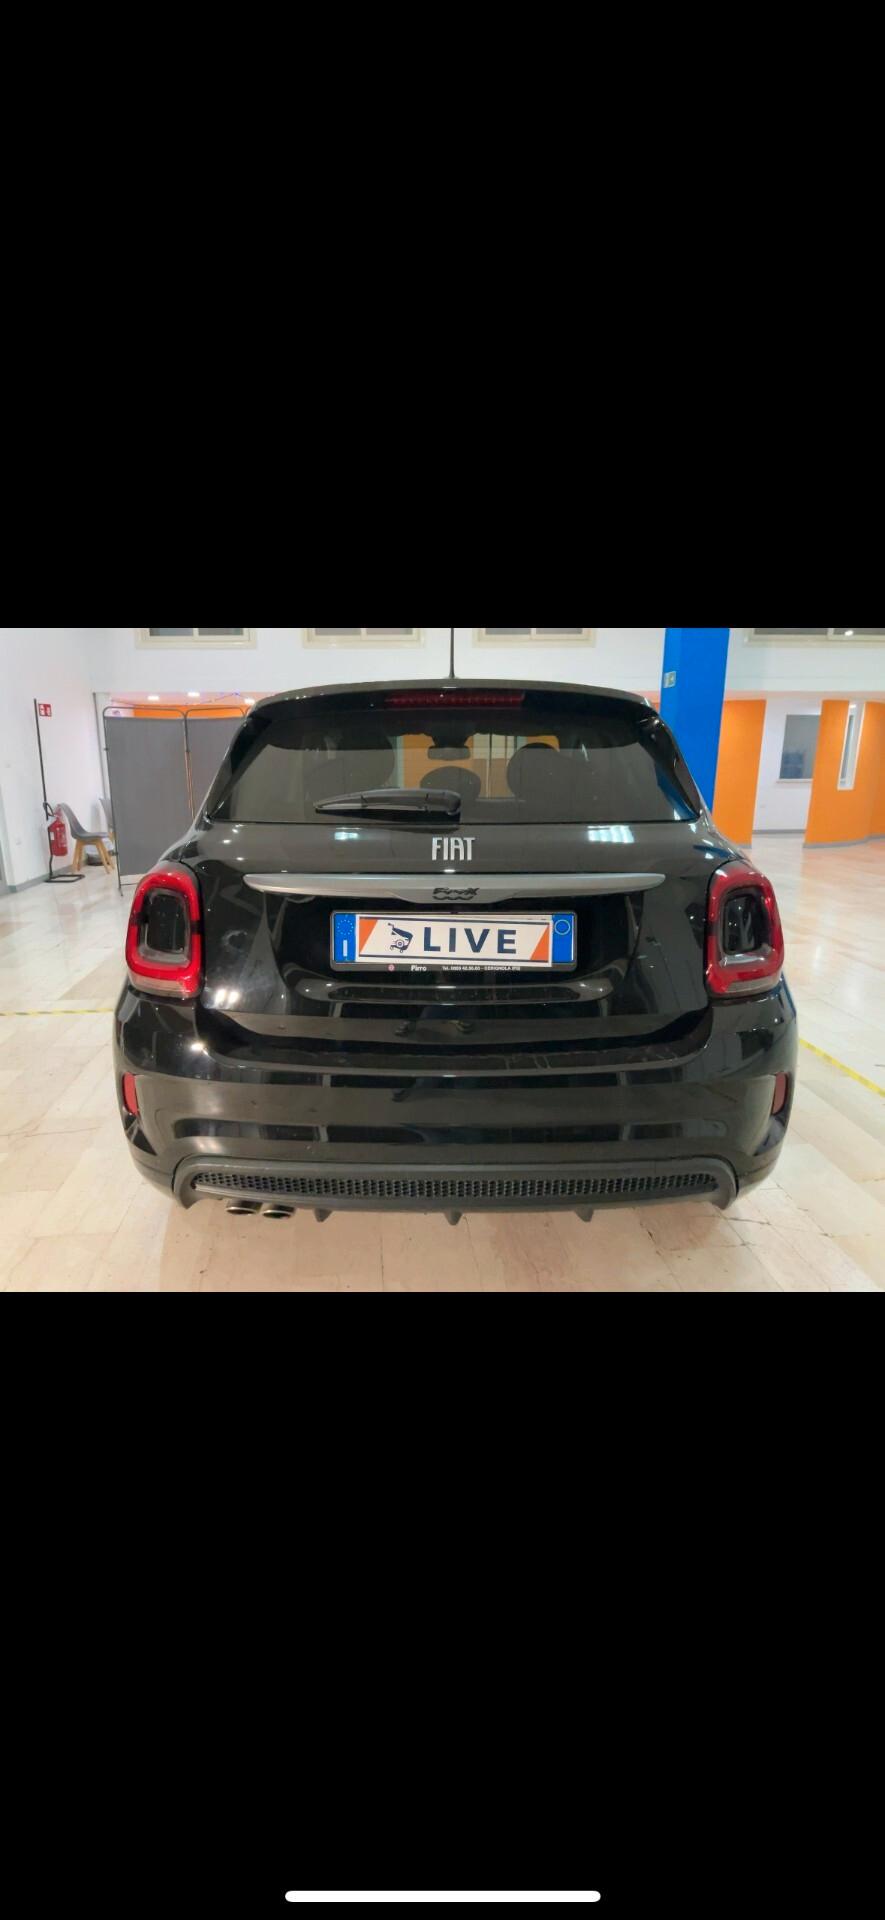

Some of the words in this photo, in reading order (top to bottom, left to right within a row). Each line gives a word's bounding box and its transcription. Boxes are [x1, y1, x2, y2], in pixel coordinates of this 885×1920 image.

[431, 837, 476, 861] FIAT
[423, 926, 517, 954] LIVE
[410, 964, 427, 972] Pirro
